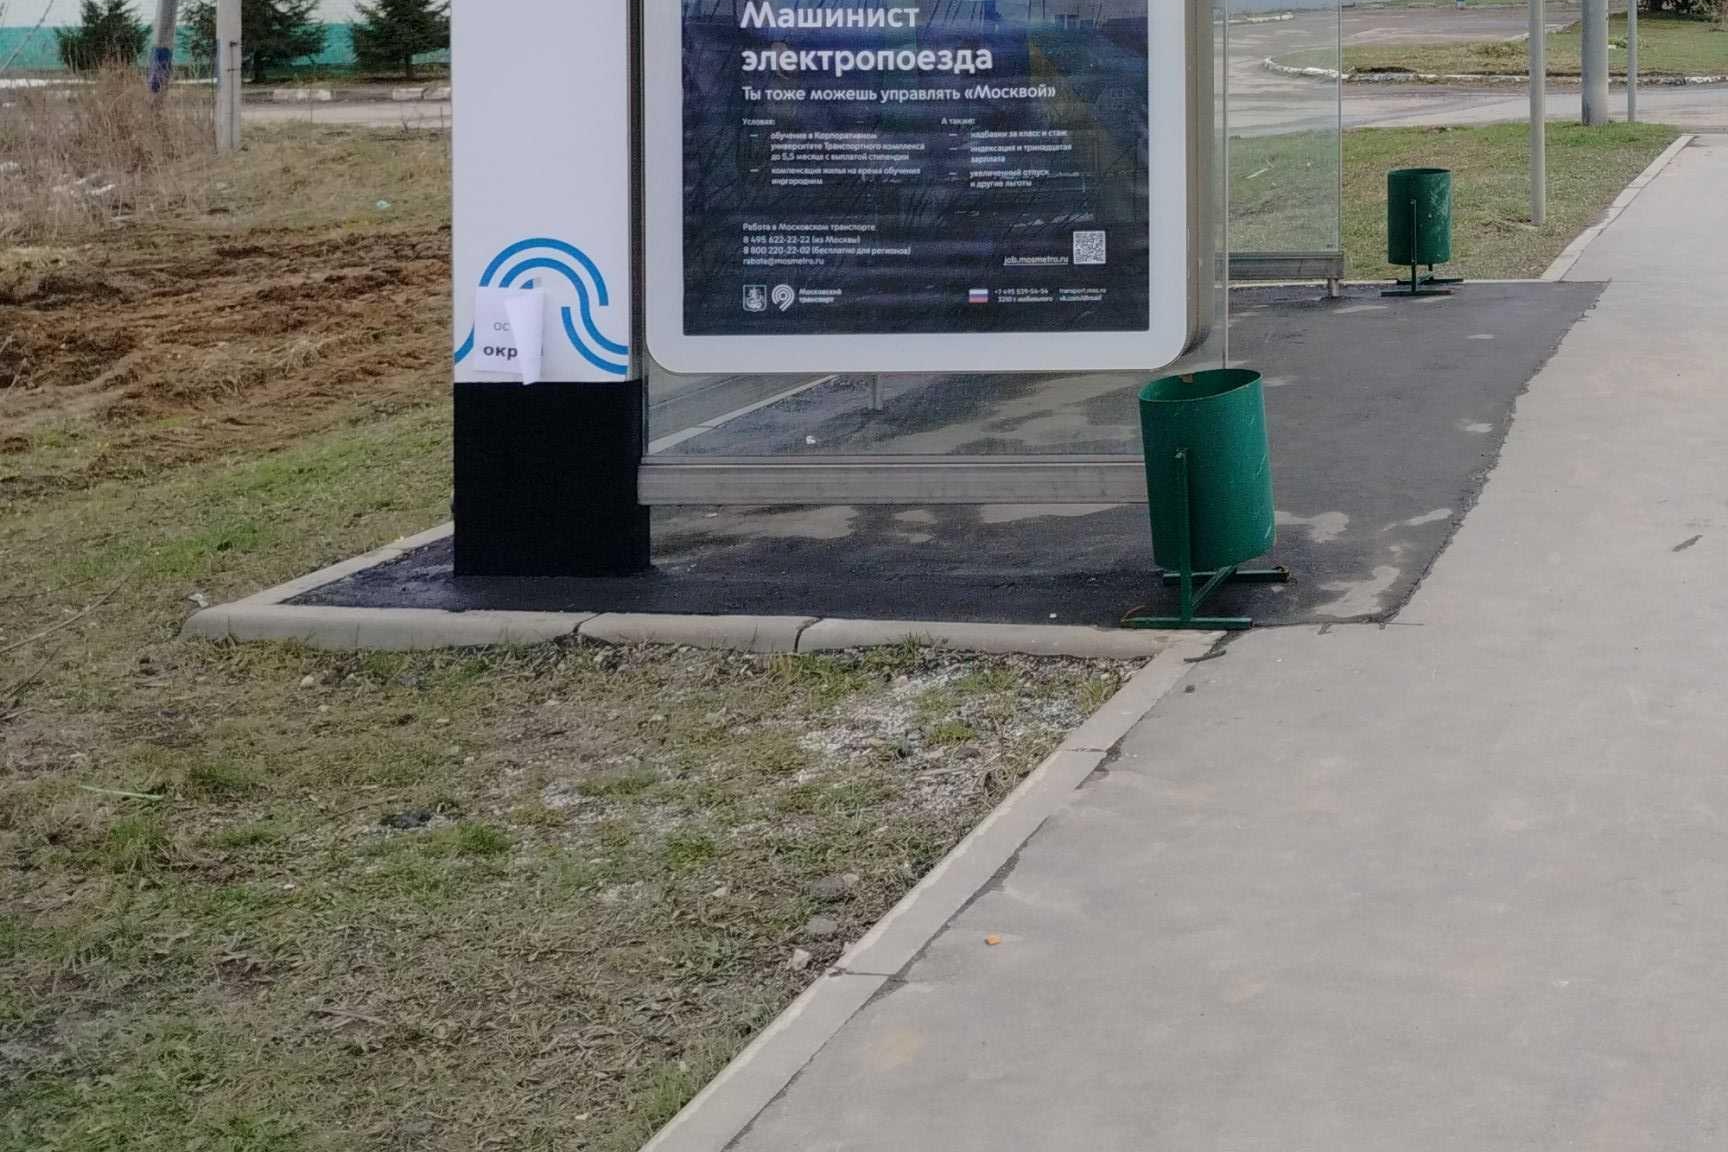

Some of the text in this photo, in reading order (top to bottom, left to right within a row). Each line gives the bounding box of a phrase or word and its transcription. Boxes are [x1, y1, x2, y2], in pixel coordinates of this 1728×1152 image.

[740, 0, 919, 28] Машинист
[741, 48, 993, 76] электропоезда
[742, 84, 1056, 103] Ты тоже можешь управлять «Москвой»
[742, 223, 771, 231] Работа
[778, 223, 829, 231] Московском
